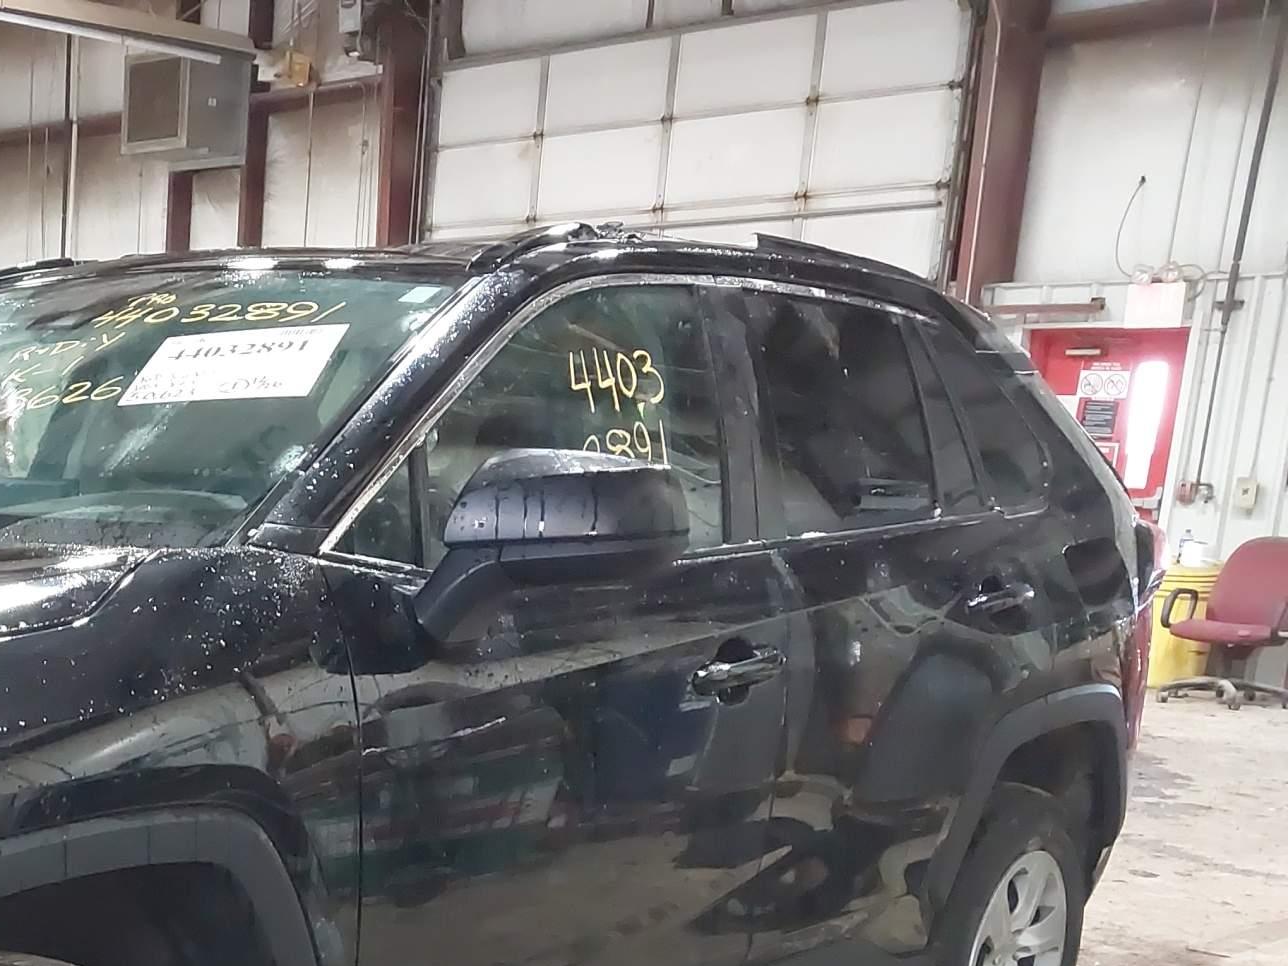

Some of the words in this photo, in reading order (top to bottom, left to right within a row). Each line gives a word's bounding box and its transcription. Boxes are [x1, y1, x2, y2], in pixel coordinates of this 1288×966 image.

[91, 301, 347, 330] 44032891
[167, 340, 309, 360] 44032891
[569, 347, 665, 414] 4403
